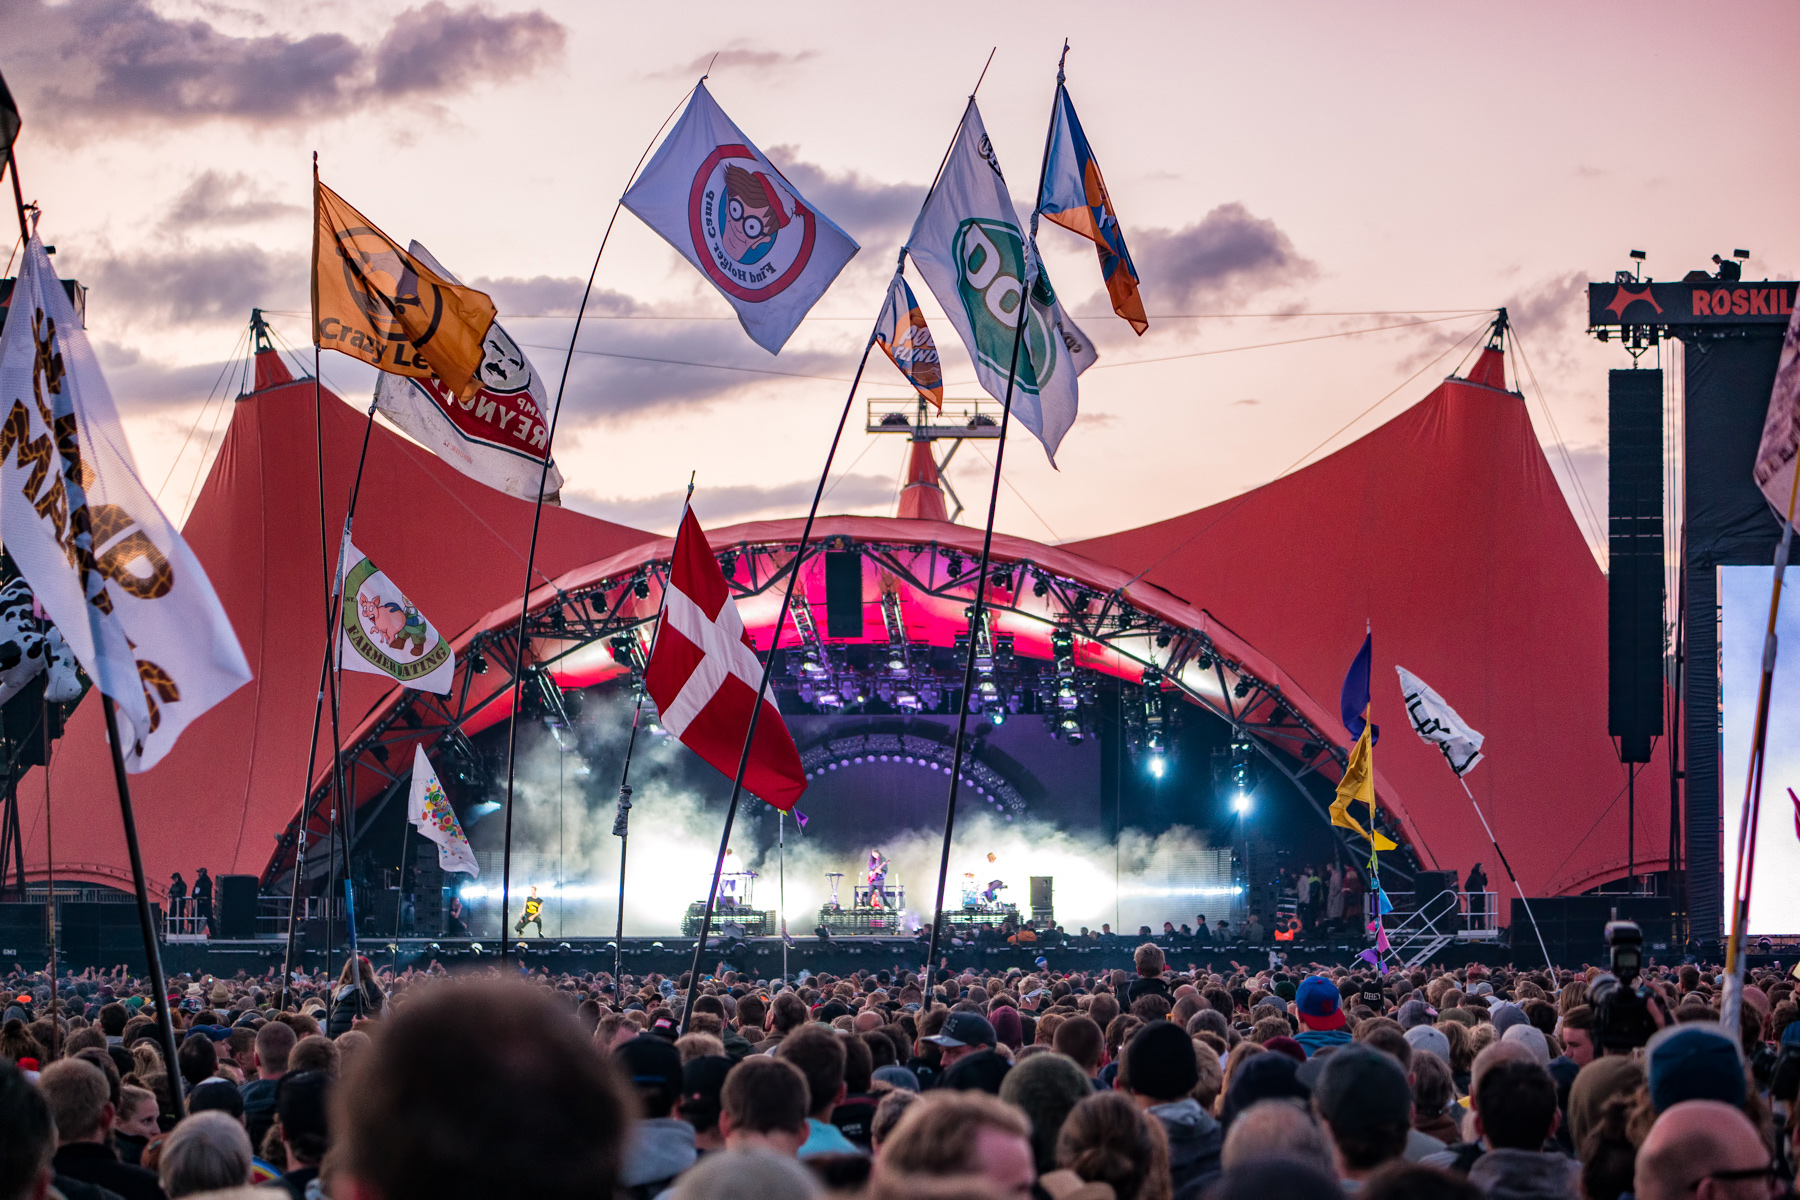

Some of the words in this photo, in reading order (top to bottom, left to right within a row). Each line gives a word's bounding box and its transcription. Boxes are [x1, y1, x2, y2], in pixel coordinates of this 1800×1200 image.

[319, 317, 388, 364] Crazy
[894, 346, 940, 364] FLYND
[1363, 991, 1381, 1001] OBEY
